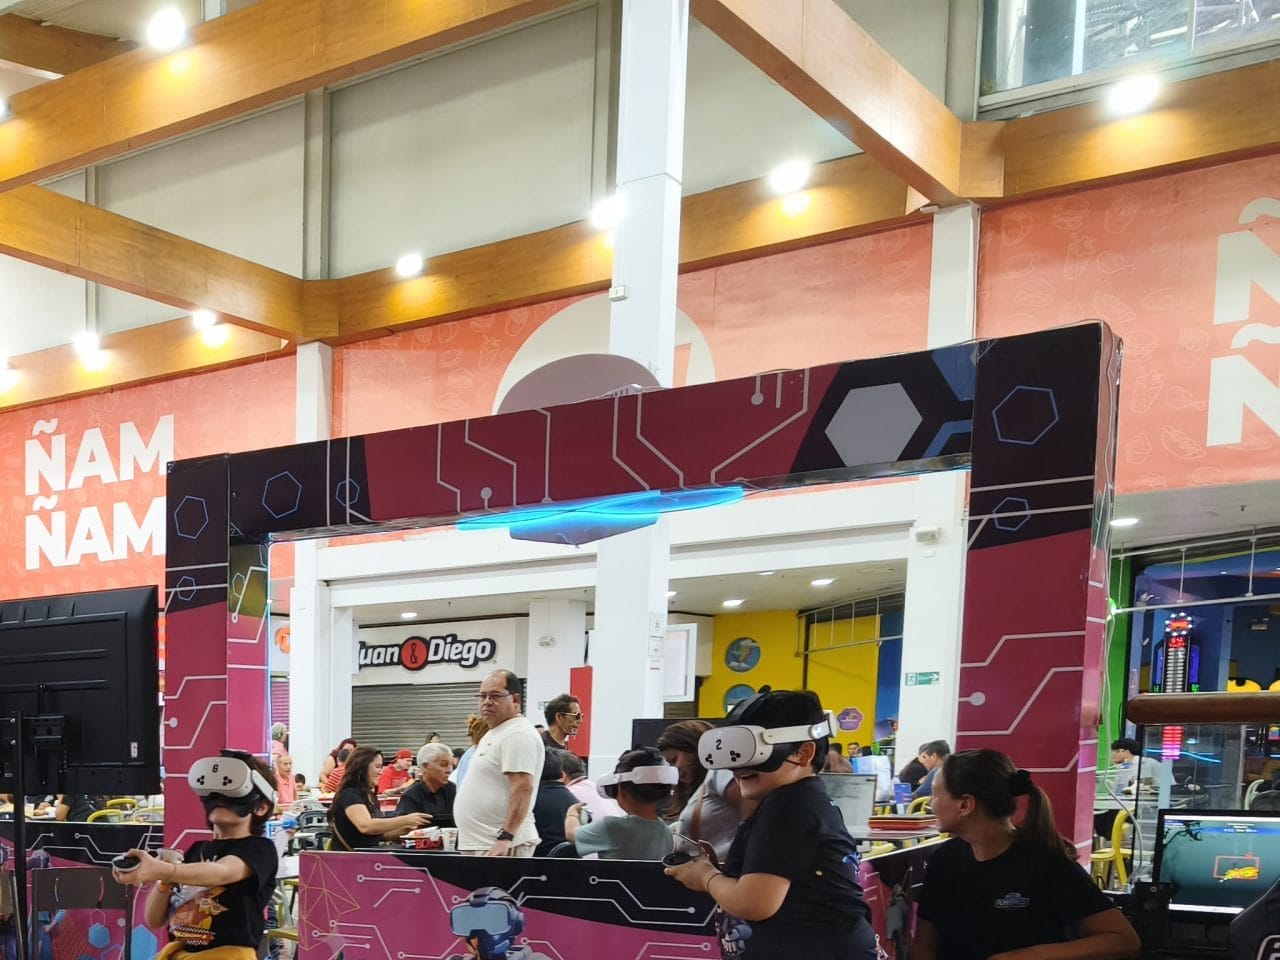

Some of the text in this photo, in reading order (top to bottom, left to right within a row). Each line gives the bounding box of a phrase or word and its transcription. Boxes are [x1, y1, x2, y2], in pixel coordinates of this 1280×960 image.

[25, 414, 174, 495] ÑAM
[25, 494, 167, 570] ÑAM
[359, 645, 399, 665] uan
[428, 636, 491, 666] Diego
[716, 739, 722, 750] 2
[212, 764, 219, 773] 6
